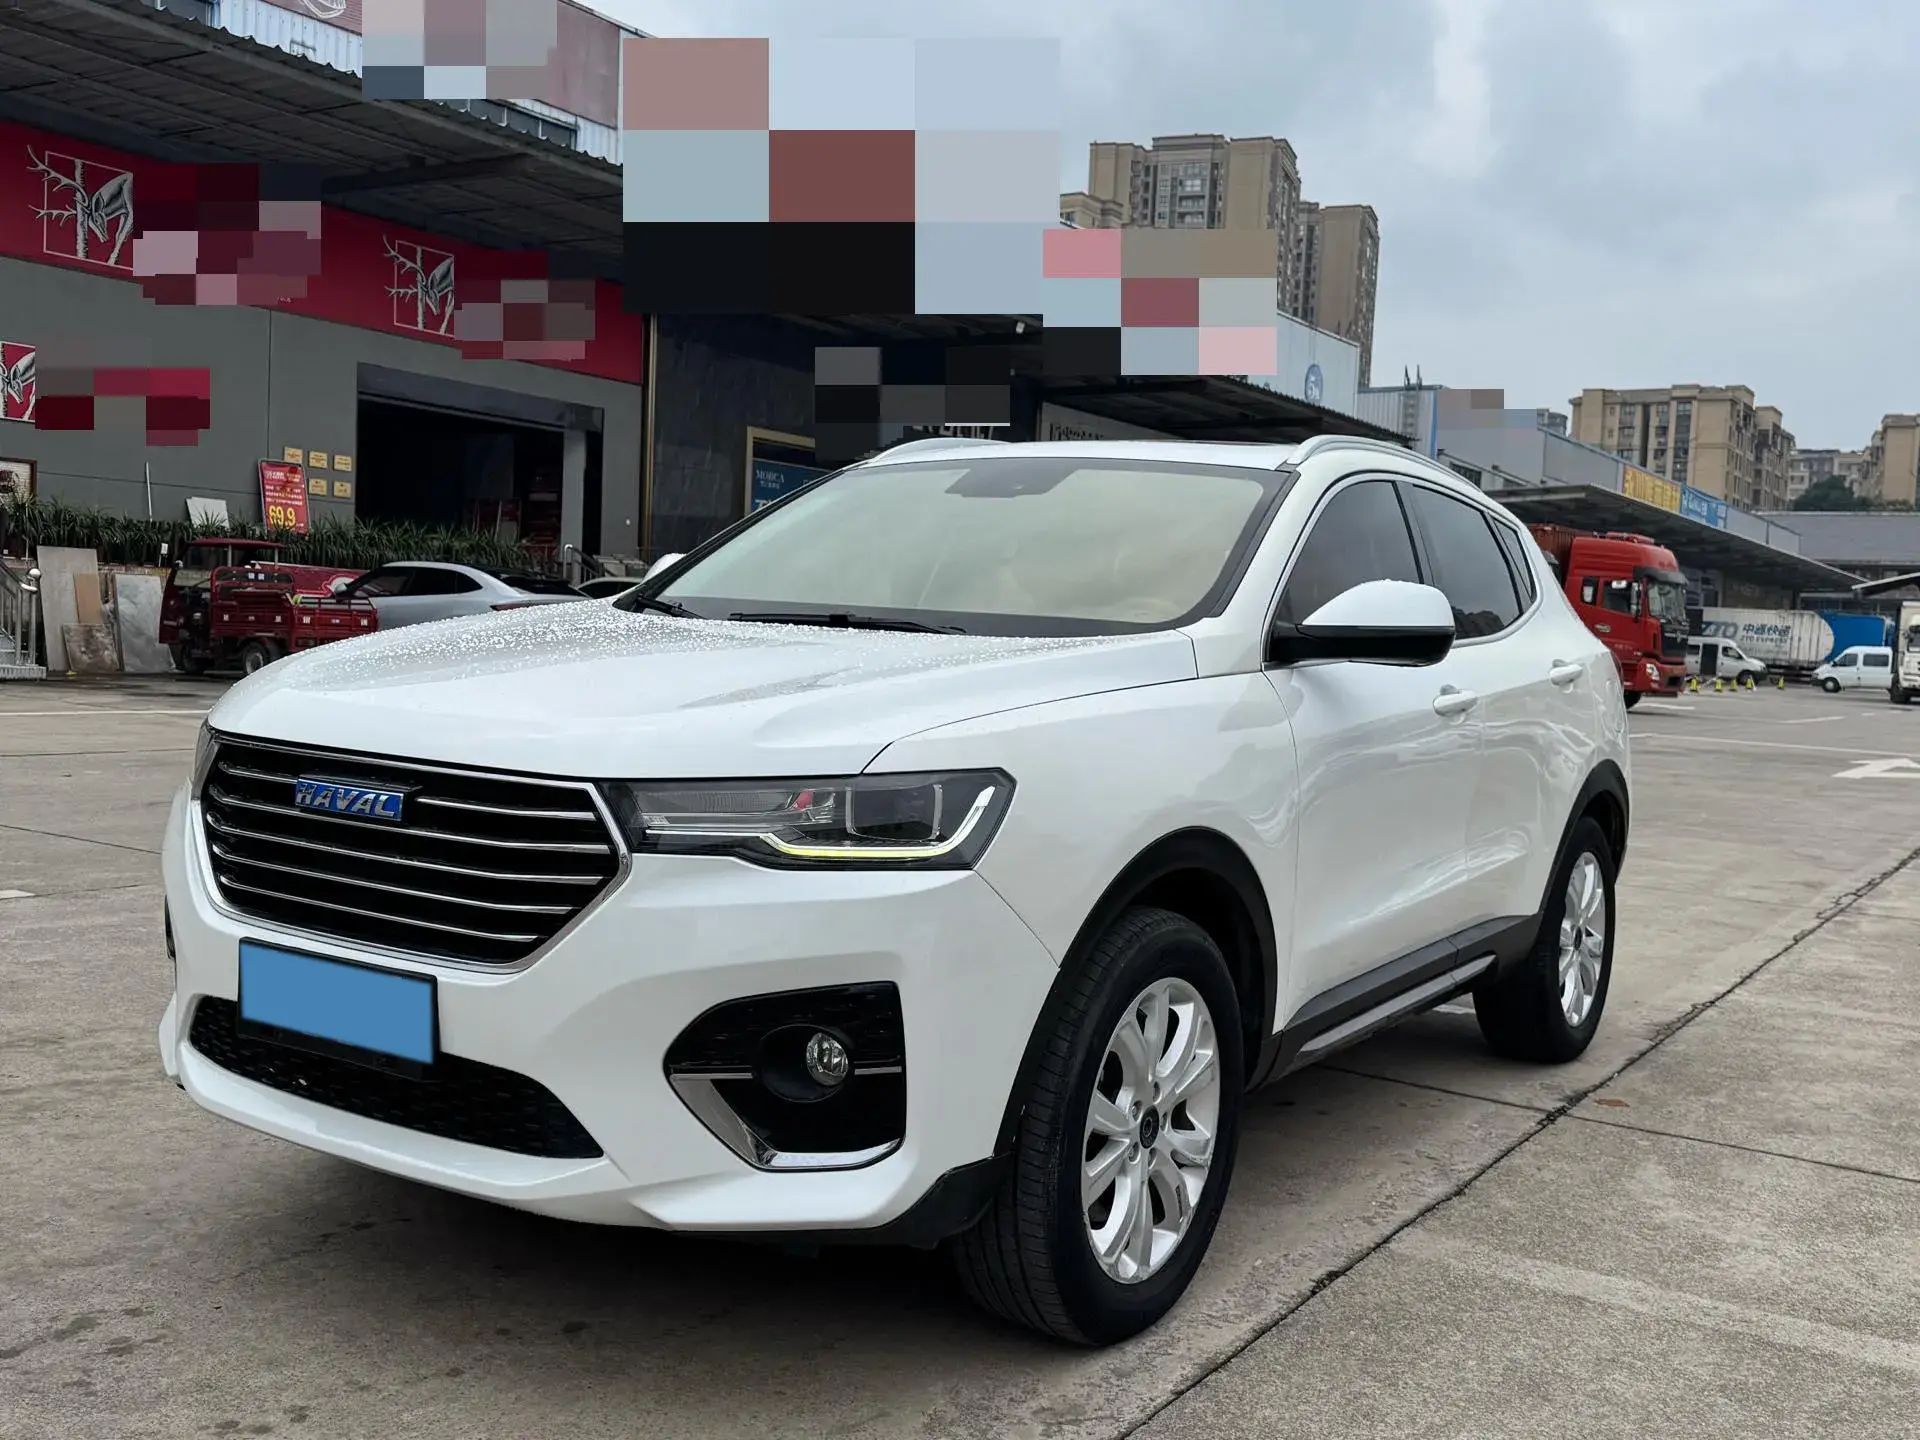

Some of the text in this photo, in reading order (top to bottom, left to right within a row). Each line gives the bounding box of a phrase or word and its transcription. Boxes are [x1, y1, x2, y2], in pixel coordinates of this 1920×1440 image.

[268, 505, 296, 528] 69.9
[1742, 623, 1791, 637] 中通快递
[295, 783, 397, 817] HAVAL
